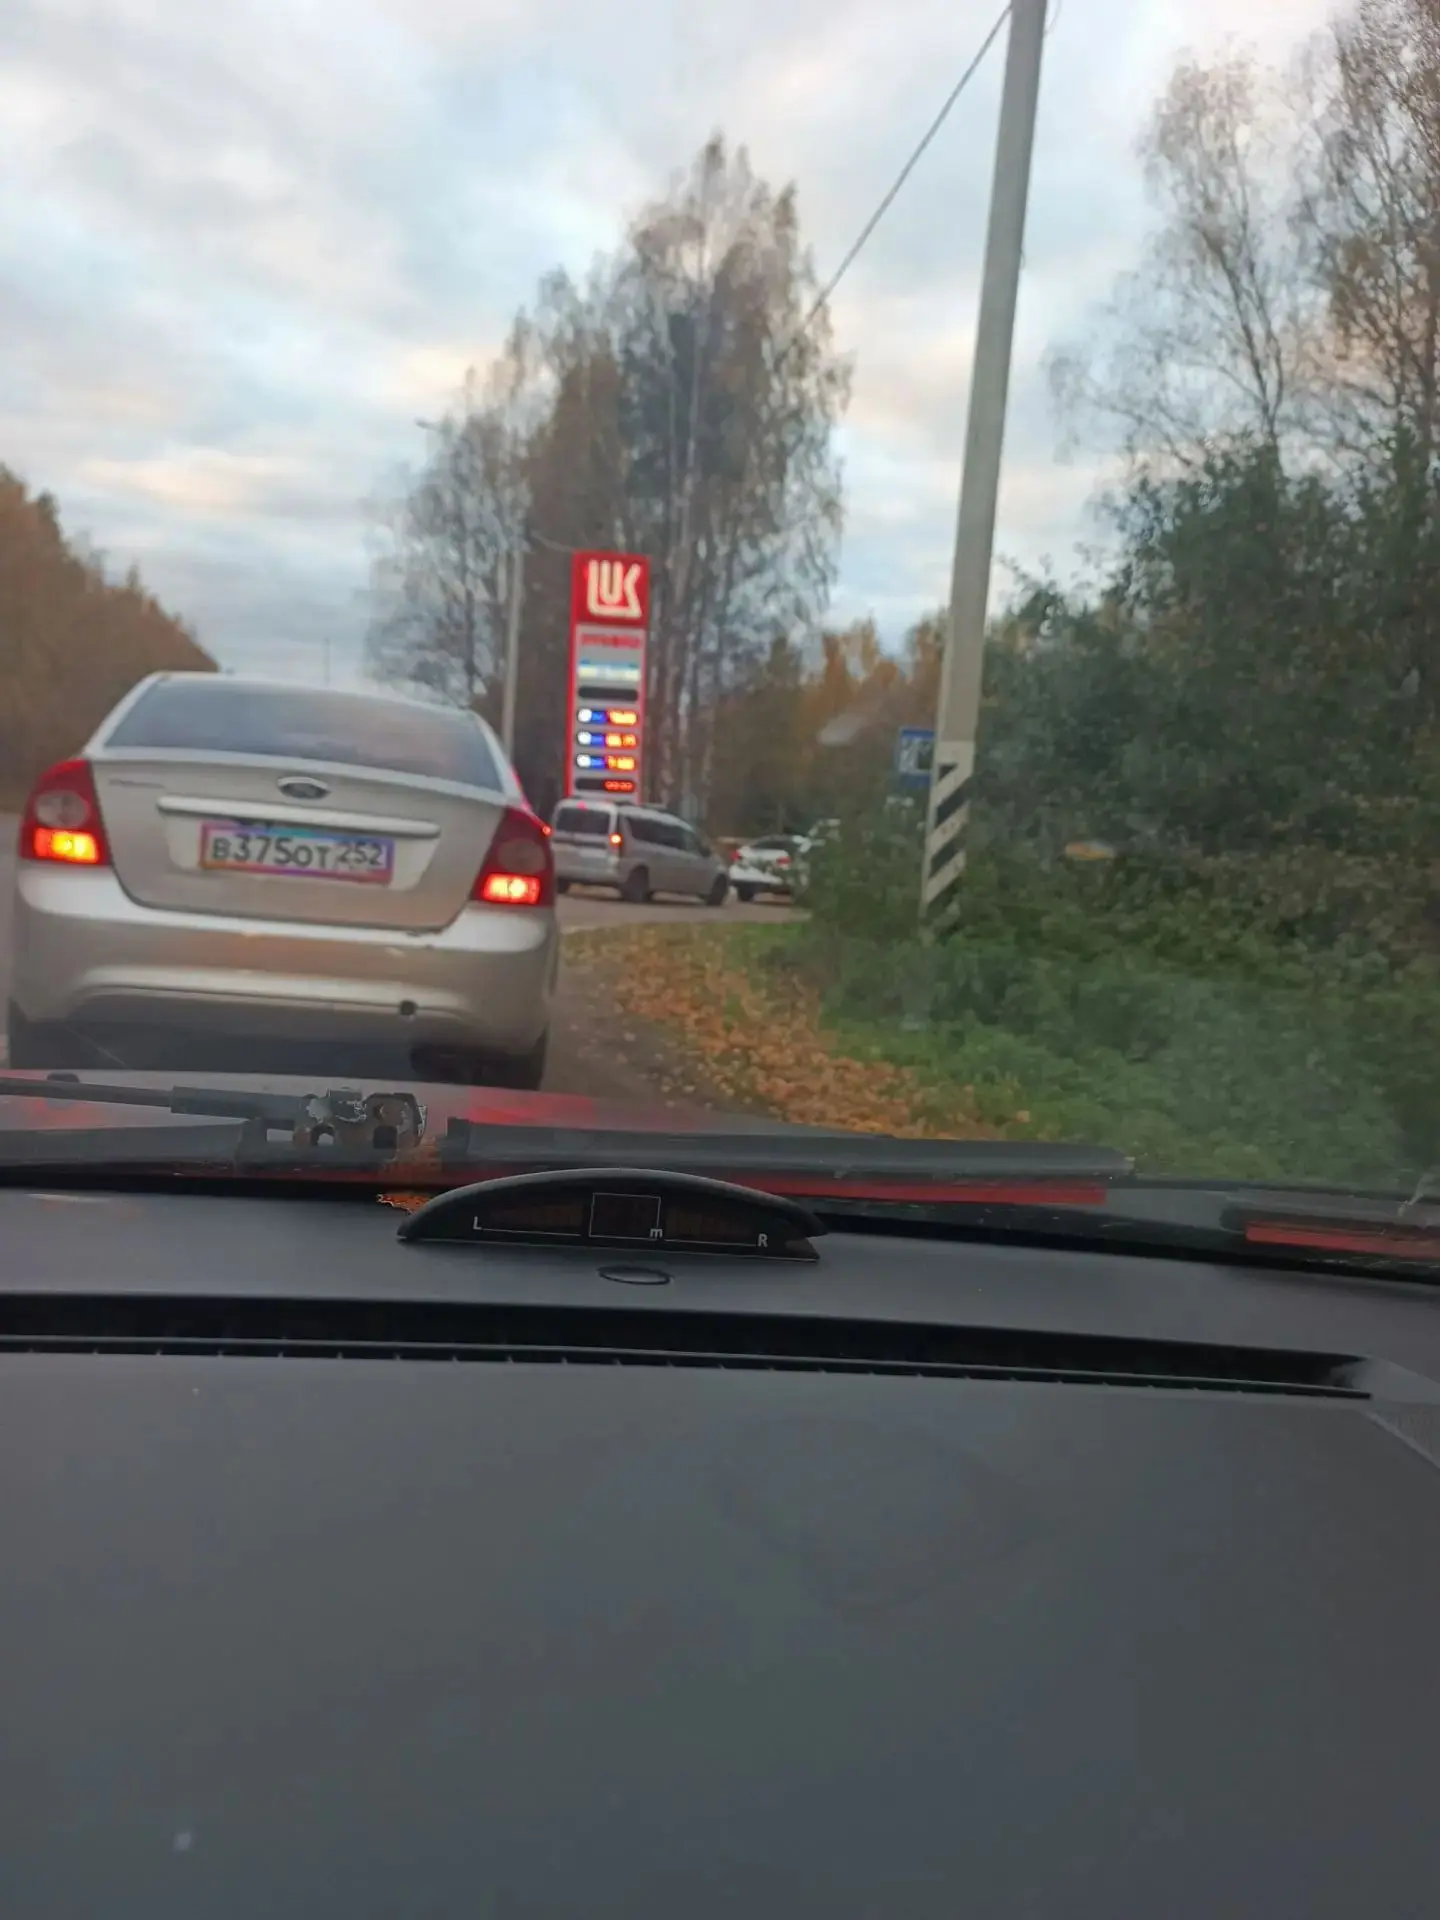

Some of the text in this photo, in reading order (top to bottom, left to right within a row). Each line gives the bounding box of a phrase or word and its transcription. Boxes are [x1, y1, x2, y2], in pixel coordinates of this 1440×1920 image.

[473, 1216, 482, 1230] L
[650, 1227, 662, 1239] m
[758, 1234, 768, 1247] R
